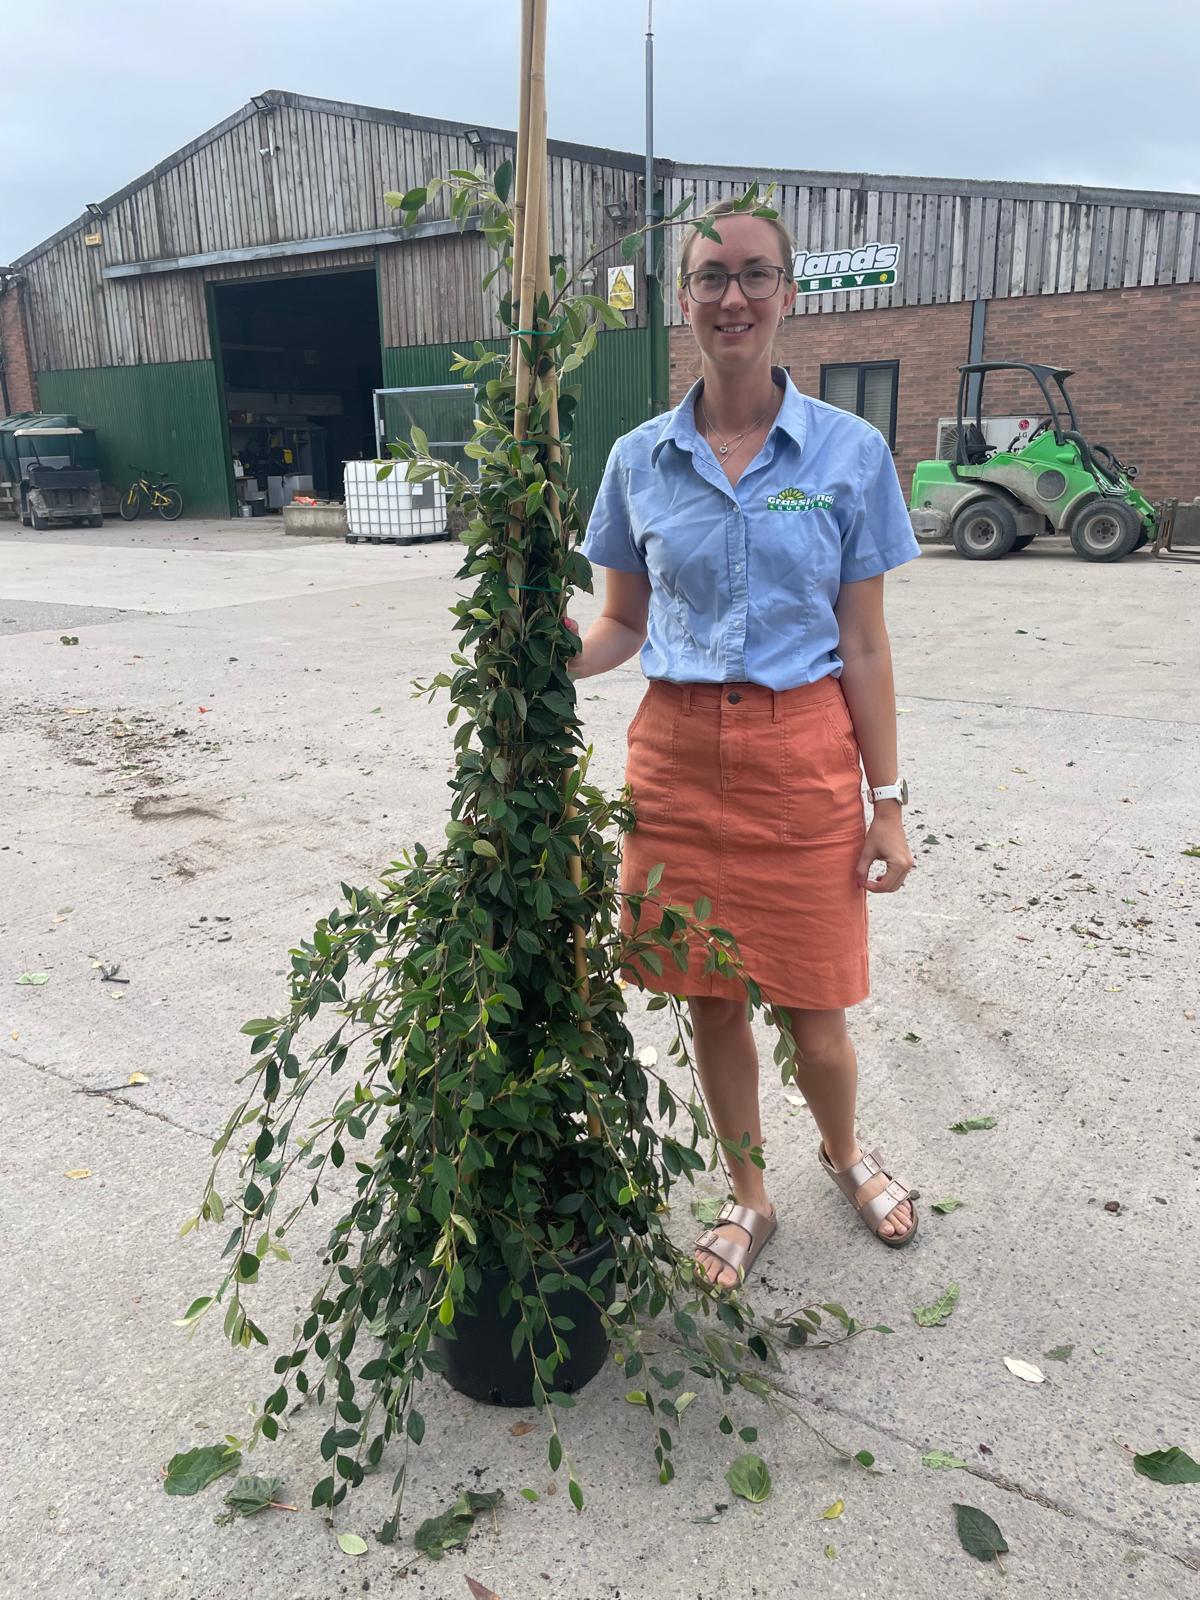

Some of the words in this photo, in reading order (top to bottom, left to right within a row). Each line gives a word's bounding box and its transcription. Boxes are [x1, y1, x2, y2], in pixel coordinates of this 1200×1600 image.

[793, 245, 898, 277] lands
[810, 275, 865, 290] ERY
[767, 494, 834, 505] Grasslnd
[778, 501, 829, 511] NURSRY
